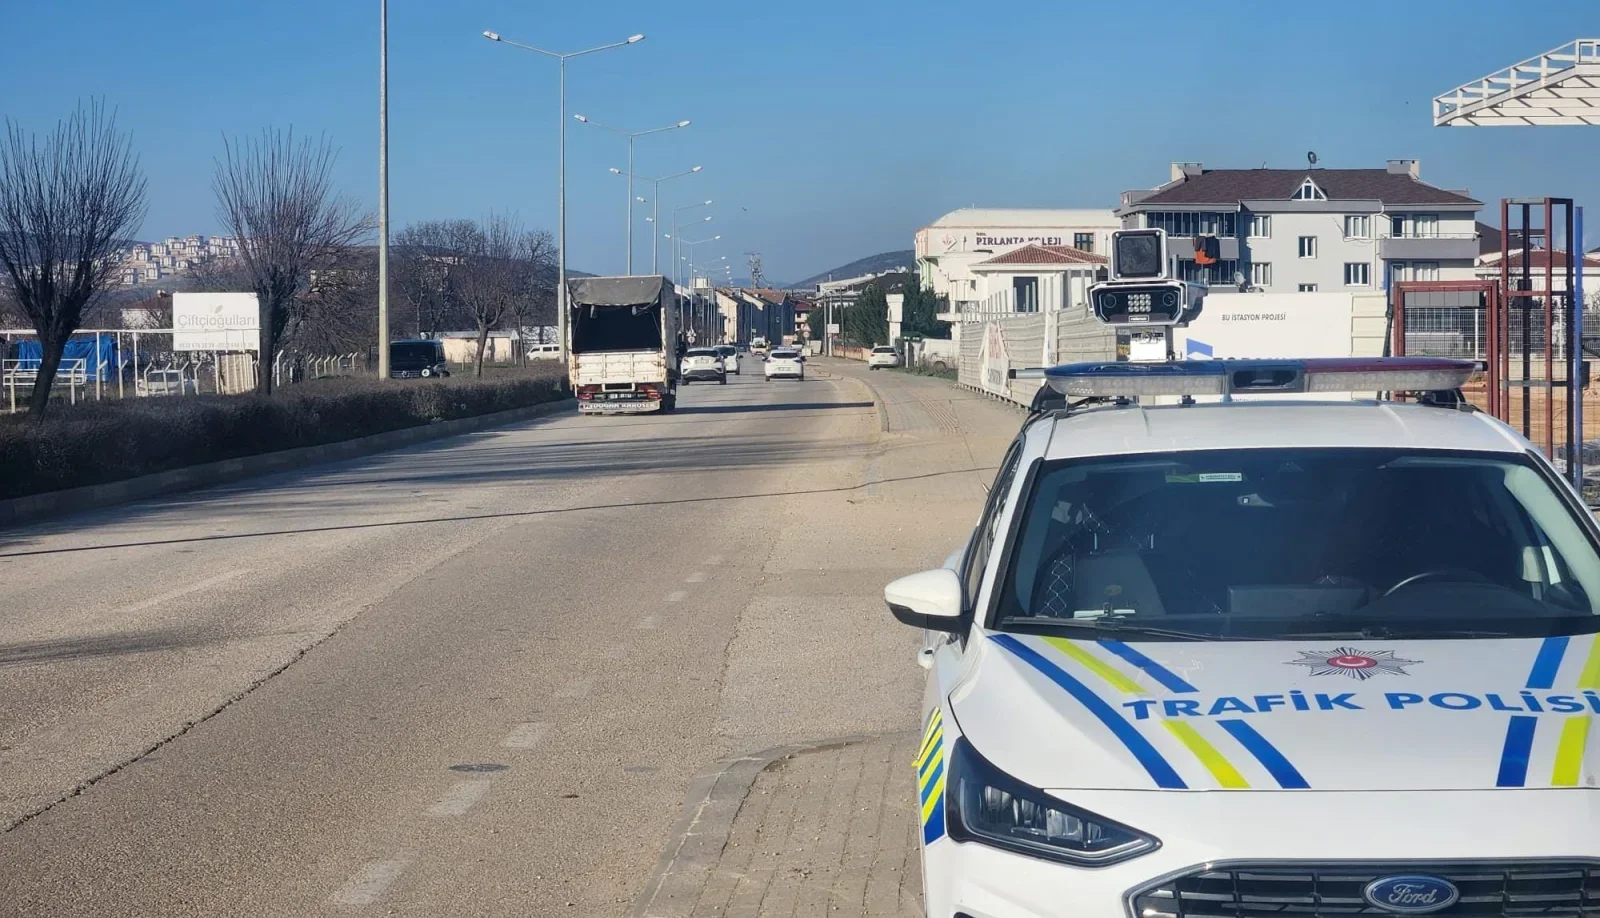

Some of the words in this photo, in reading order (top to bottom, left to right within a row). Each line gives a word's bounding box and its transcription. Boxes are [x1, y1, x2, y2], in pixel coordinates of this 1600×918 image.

[177, 314, 256, 329] Çiftçioğulları
[1231, 312, 1261, 321] İSTASYON
[1262, 312, 1286, 321] PROJESİ
[1122, 689, 1367, 720] TRAFİK
[1386, 690, 1600, 714] POLİSİ
[1388, 883, 1438, 904] Ford
